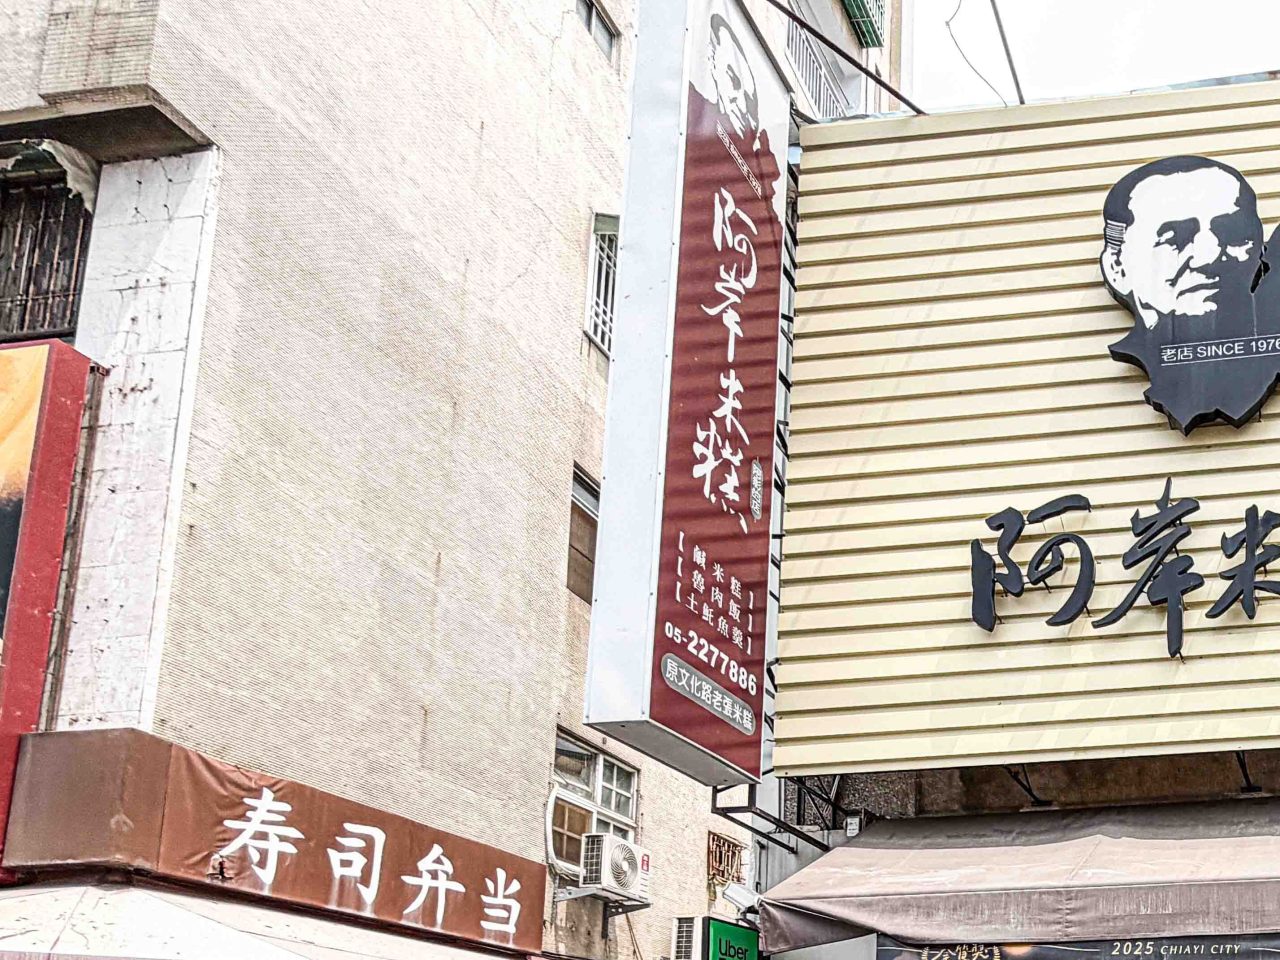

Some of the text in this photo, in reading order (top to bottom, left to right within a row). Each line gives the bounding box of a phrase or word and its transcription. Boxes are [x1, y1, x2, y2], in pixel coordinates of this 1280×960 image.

[691, 187, 758, 534] 阿岸米糕
[1161, 347, 1193, 362] 老店
[1196, 342, 1245, 358] SINCE
[664, 622, 757, 696] 05-2277886
[665, 658, 754, 731] 原文化路老張米糕
[218, 787, 521, 934] 寿司弁当
[718, 937, 749, 960] Uber
[1111, 941, 1241, 956] 2025 CHIAYI CITY
